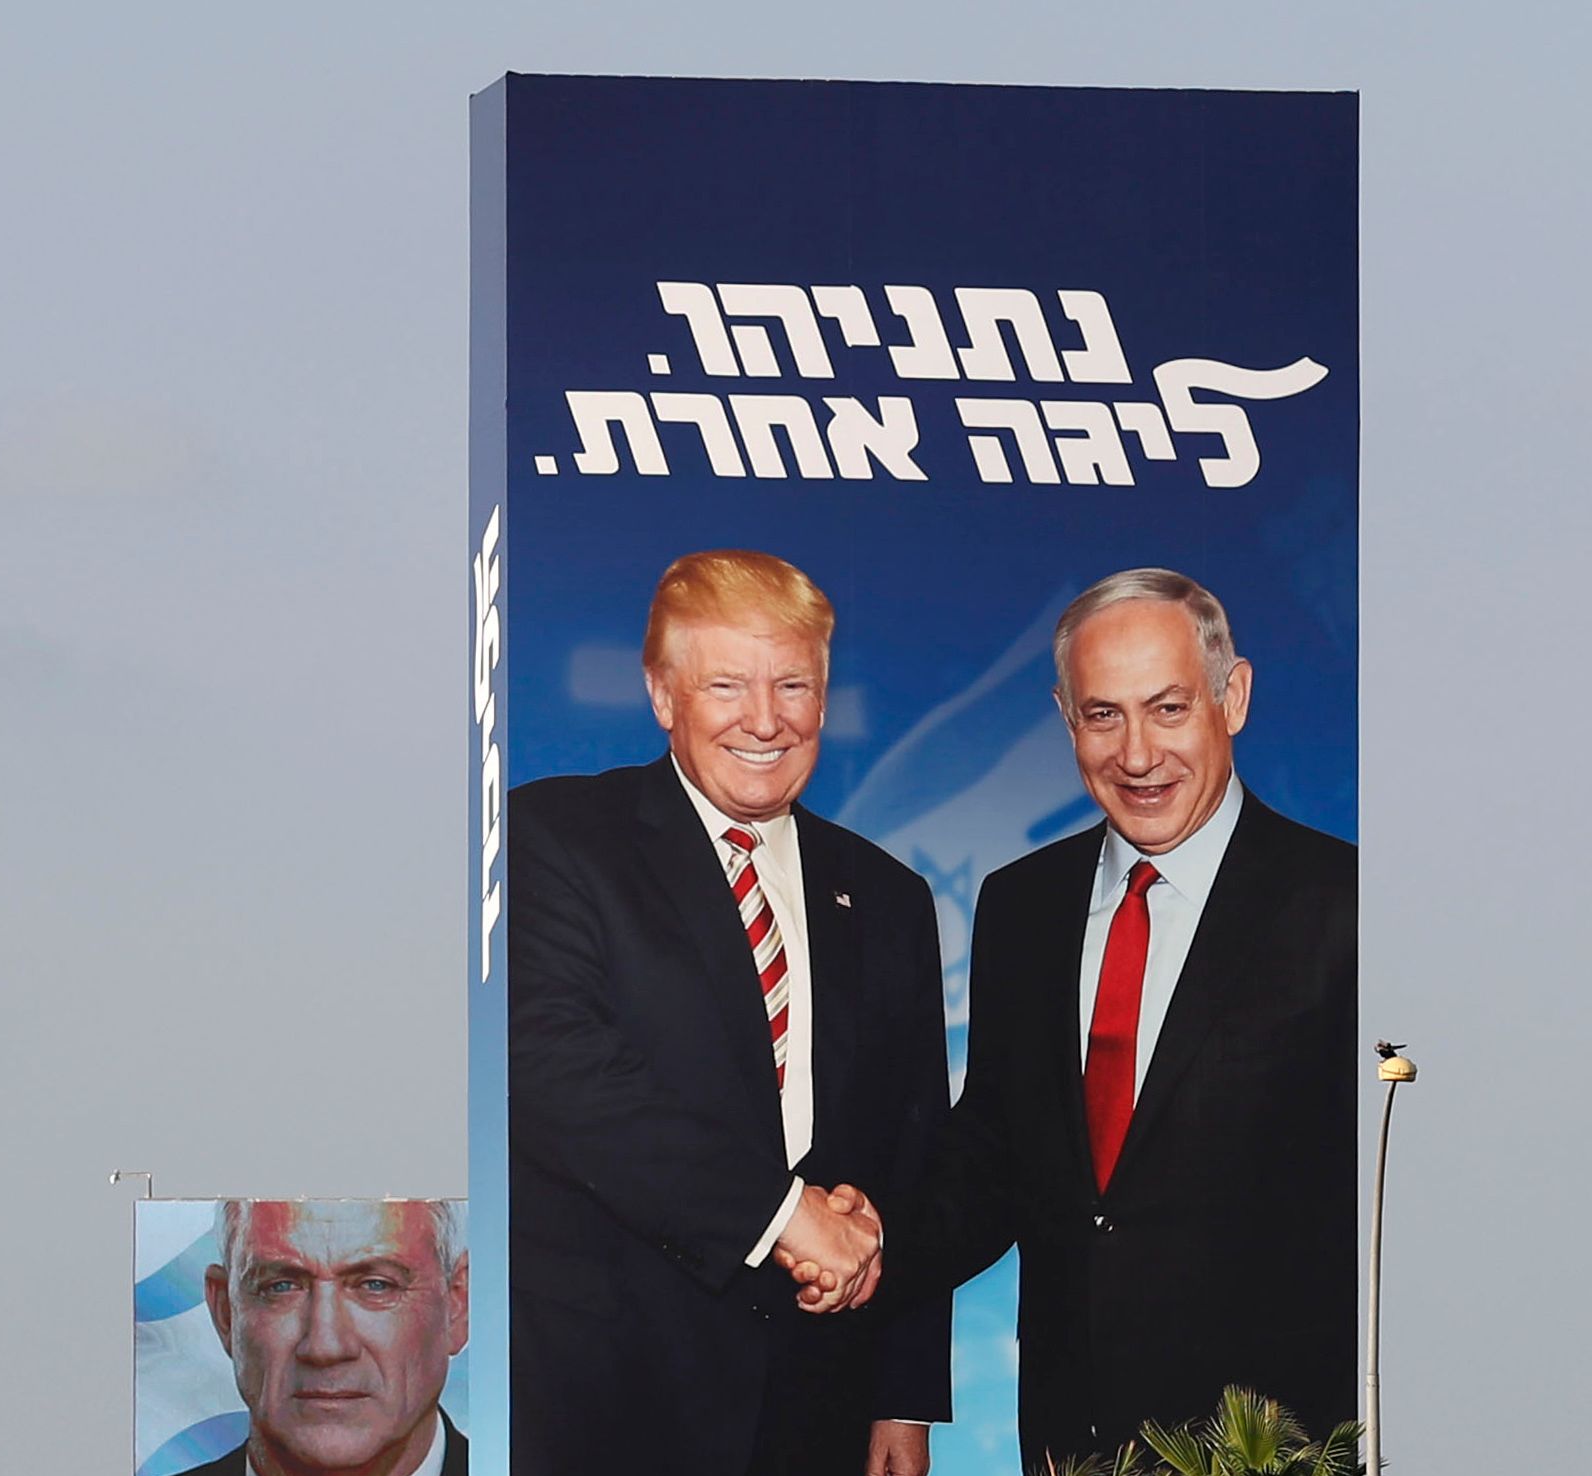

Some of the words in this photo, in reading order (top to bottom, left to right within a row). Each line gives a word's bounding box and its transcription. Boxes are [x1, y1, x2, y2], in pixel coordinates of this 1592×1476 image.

[648, 281, 1133, 384] נתניהו.
[535, 391, 929, 481] אחרת.
[955, 356, 1329, 488] ליגה
[473, 504, 500, 984] הליכוד
